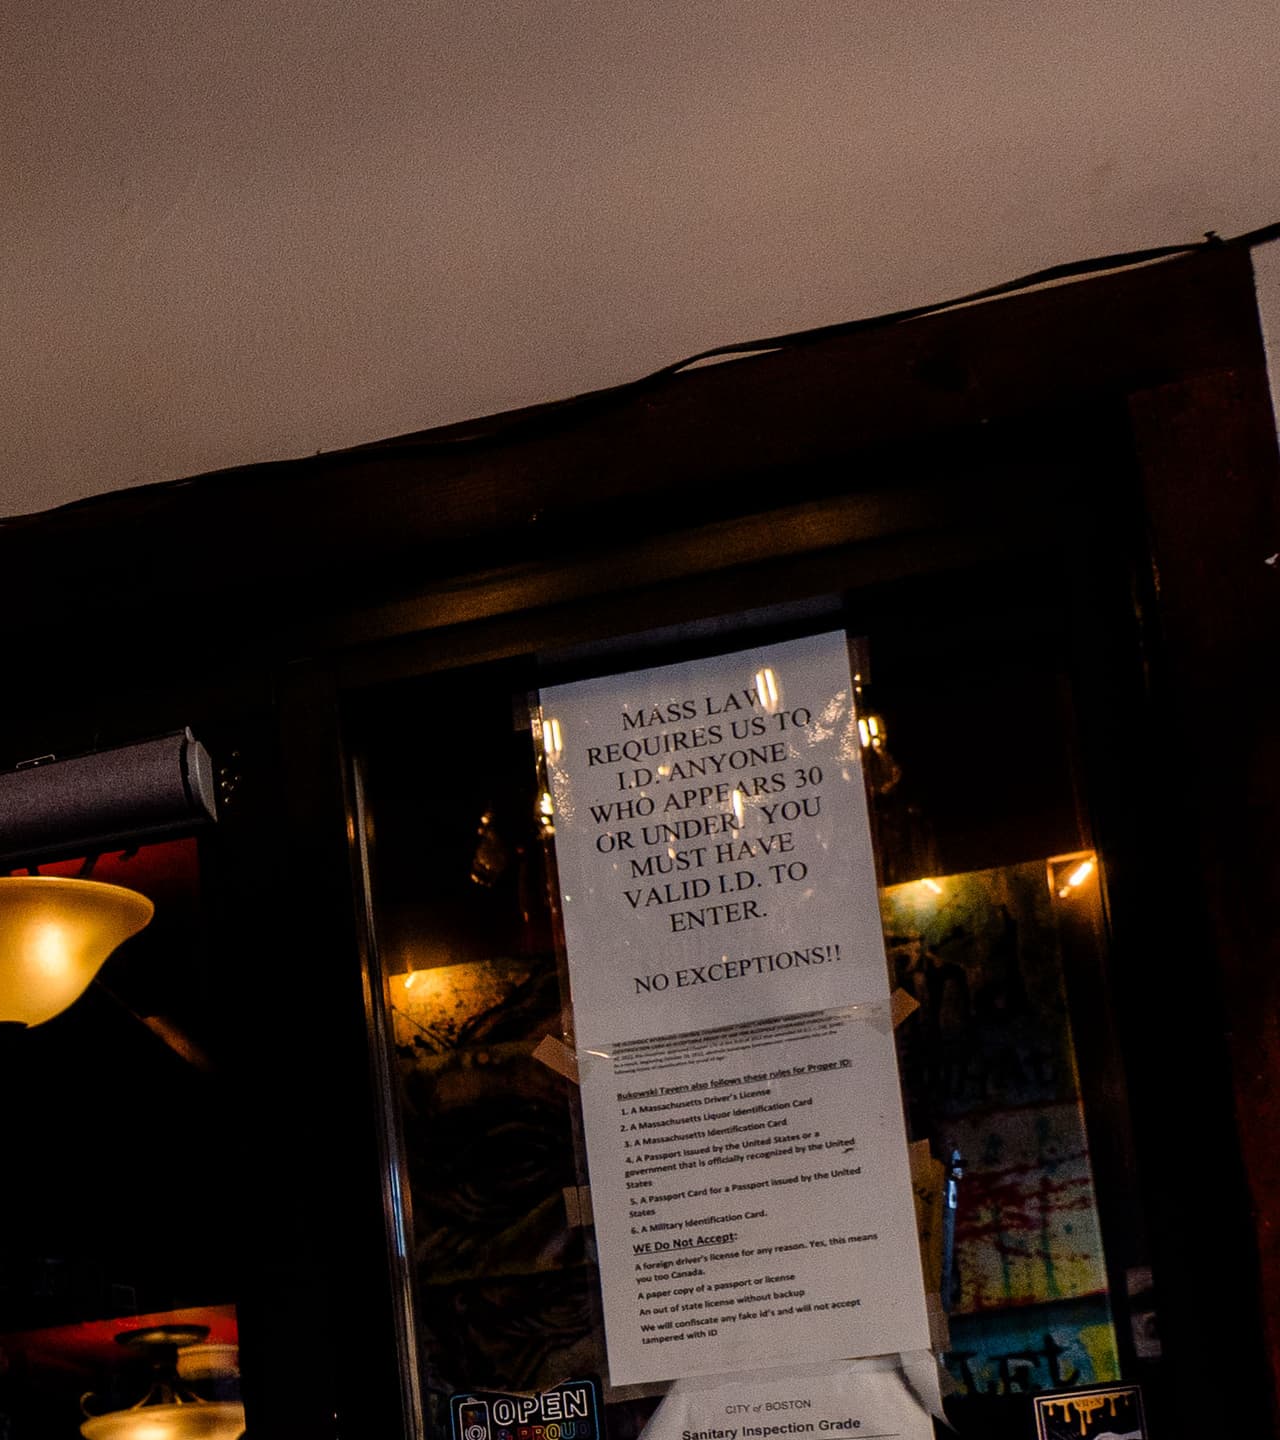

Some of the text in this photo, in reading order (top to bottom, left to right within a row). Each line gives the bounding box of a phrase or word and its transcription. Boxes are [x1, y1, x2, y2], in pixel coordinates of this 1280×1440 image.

[587, 707, 812, 767] REQUIRES US TO
[622, 700, 697, 731] MASS
[617, 742, 788, 792] I.D. ANYONE
[590, 766, 824, 825] WHO APPEARS 30
[596, 831, 635, 854] OR
[761, 796, 823, 825] YOU
[630, 832, 796, 879] MUST HAVE
[624, 860, 808, 910] VALID I.D. TO
[670, 899, 768, 934] ENTER.
[633, 944, 841, 995] NO EXCEPTIONS!!
[633, 1240, 652, 1256] WE
[654, 1238, 670, 1253] Do
[672, 1236, 694, 1251] Not
[492, 1389, 588, 1427] OPEN
[725, 1399, 812, 1415] CITY BOSTON
[742, 1421, 814, 1439] Inspection
[818, 1417, 861, 1432] Grade
